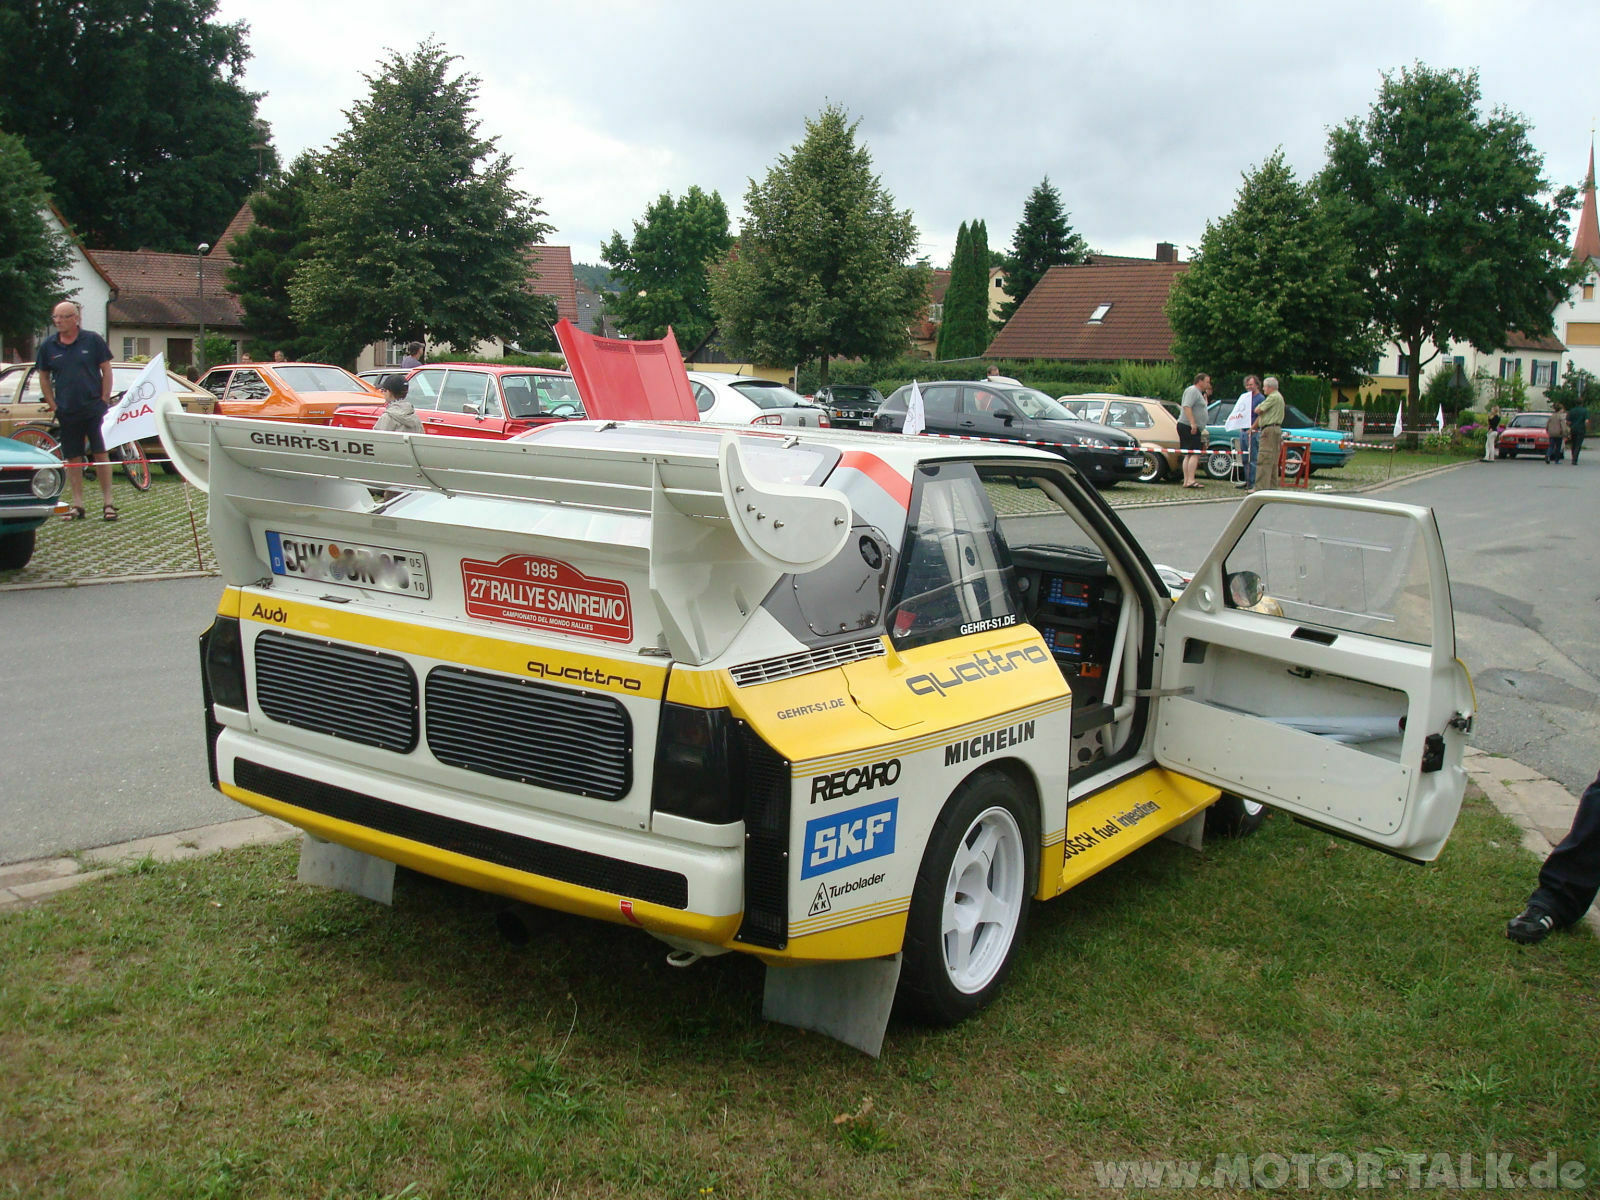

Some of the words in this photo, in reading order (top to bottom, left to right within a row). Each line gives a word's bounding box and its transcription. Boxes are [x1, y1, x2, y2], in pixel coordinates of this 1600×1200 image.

[250, 432, 375, 456] GEHRT-S1.DE
[409, 558, 422, 568] 05
[523, 560, 558, 580] 1985
[413, 581, 425, 592] 10
[490, 581, 546, 608] RALLYE
[547, 590, 625, 621] SANREMO
[251, 602, 288, 624] Audi
[502, 610, 538, 622] CAMPIONATO
[538, 616, 549, 624] DEL
[549, 618, 571, 628] MONDO
[571, 621, 594, 631] RALLIES
[960, 614, 1016, 635] GEHRT-S1.DE
[527, 660, 642, 691] quattro
[906, 645, 1049, 697] quattro
[777, 698, 846, 720] GEHRT-S1.DE
[944, 720, 1036, 767] MICHELIN
[810, 758, 901, 804] RECARO
[810, 811, 892, 867] SKF
[1091, 819, 1122, 840] fuel
[829, 872, 886, 899] Turbolader
